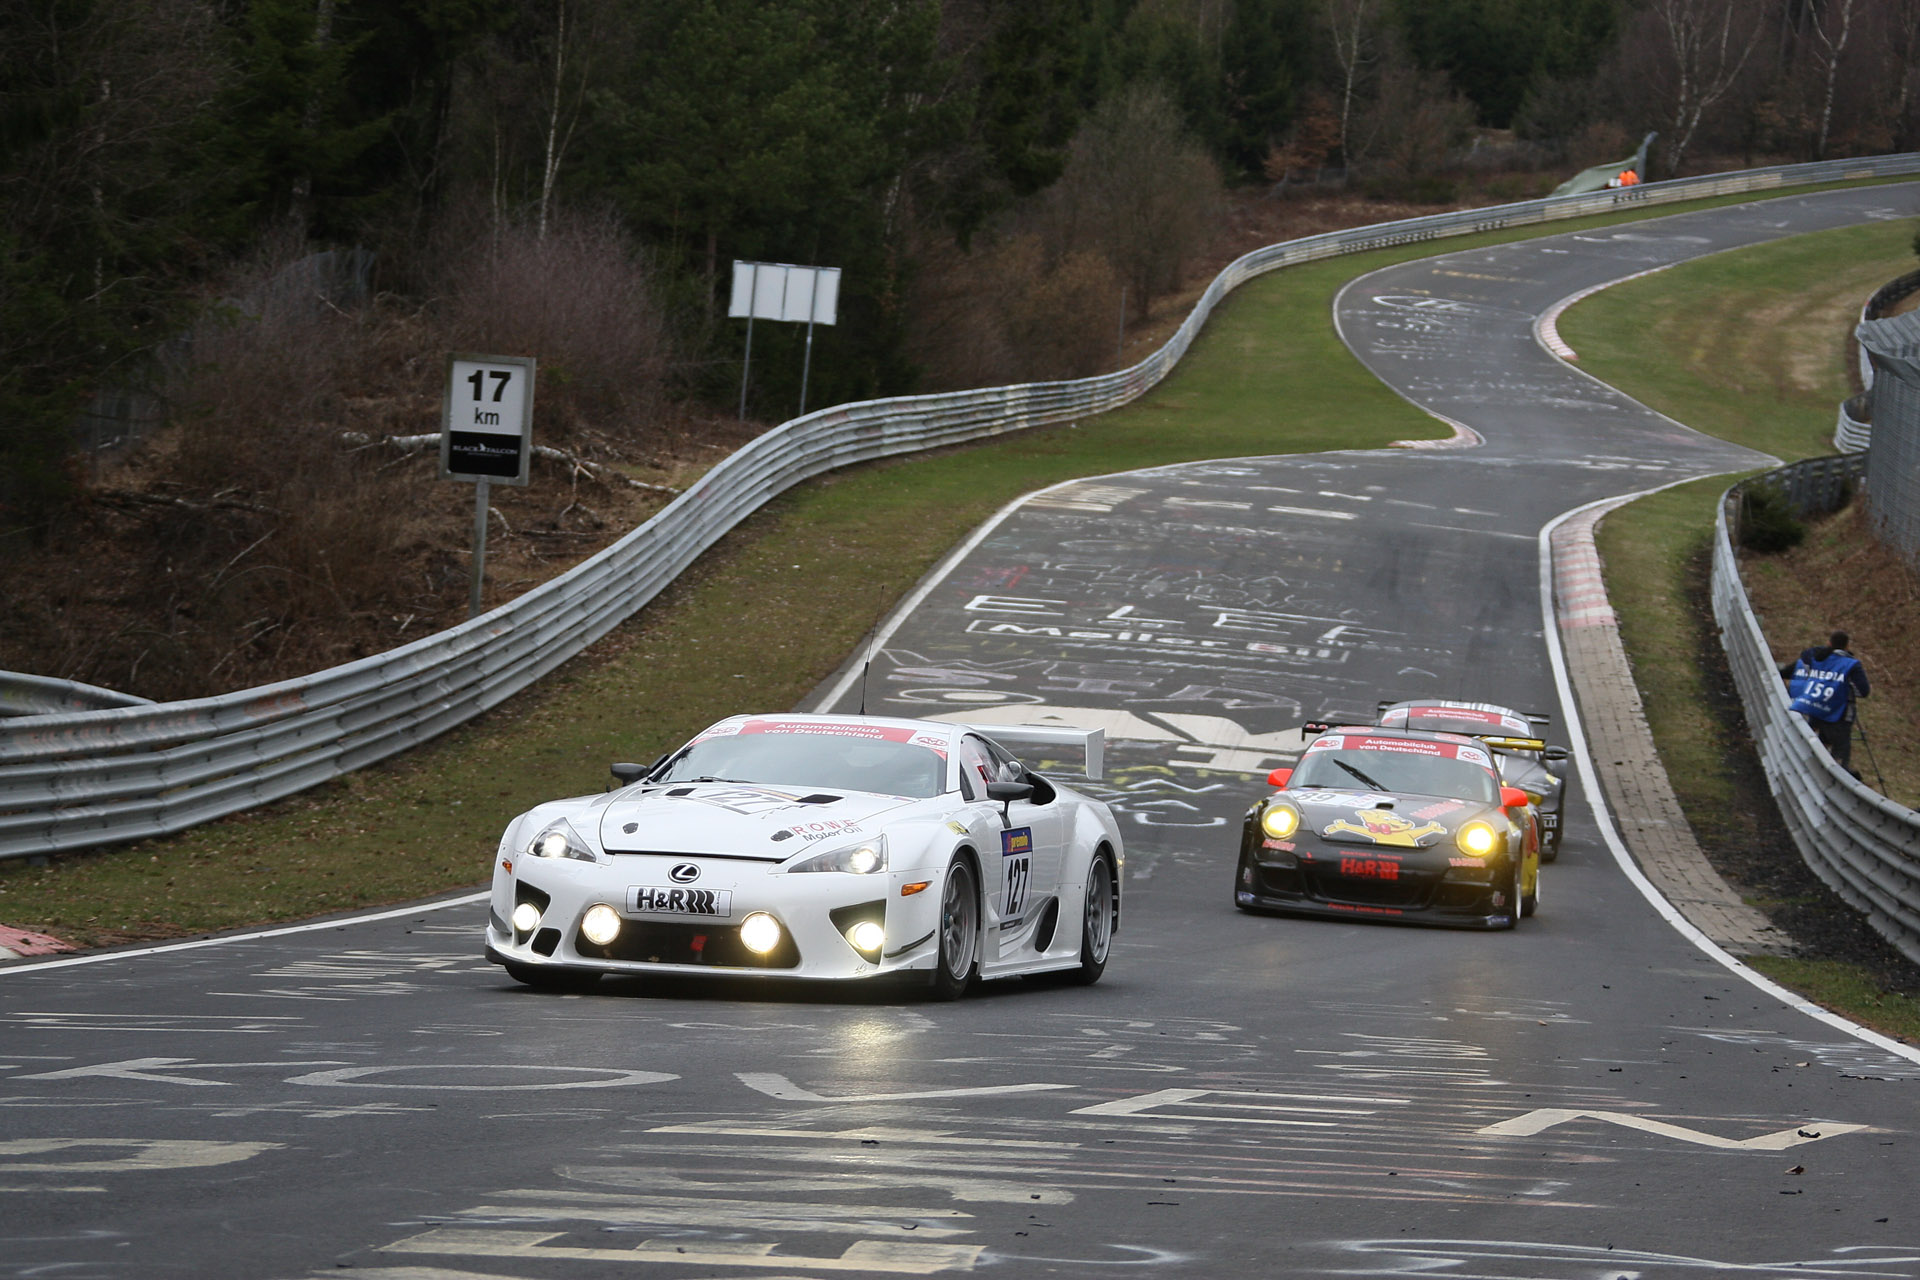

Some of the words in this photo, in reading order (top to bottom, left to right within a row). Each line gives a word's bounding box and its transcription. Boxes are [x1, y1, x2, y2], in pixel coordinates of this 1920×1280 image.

[467, 370, 512, 402] 17
[474, 407, 500, 426] km
[1804, 680, 1835, 702] 159
[775, 723, 881, 734] Automobilclub
[791, 728, 885, 740] Deutschland
[1365, 738, 1437, 750] Automobilclub
[1378, 744, 1441, 756] Deutschland
[791, 818, 858, 836] ROWE
[802, 827, 842, 843] Motor
[843, 825, 864, 835] Oil
[1005, 857, 1030, 916] 127
